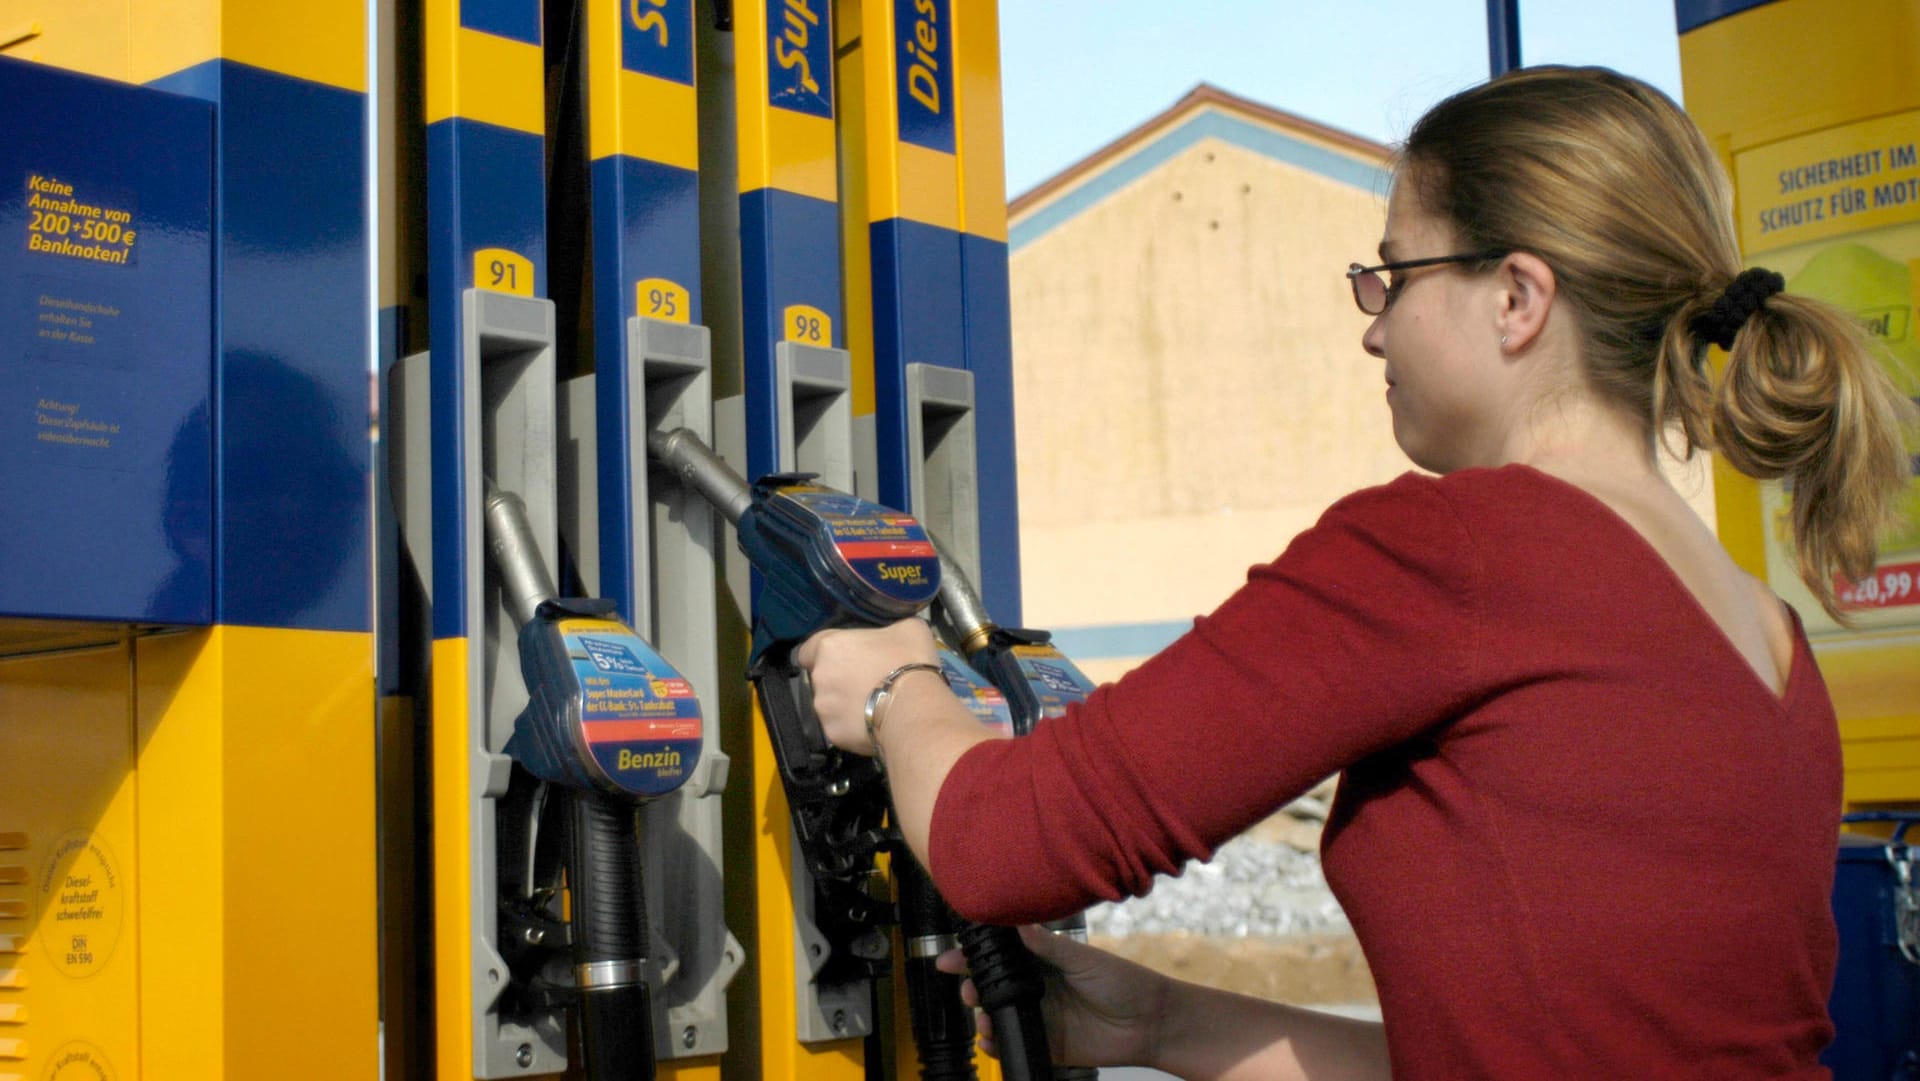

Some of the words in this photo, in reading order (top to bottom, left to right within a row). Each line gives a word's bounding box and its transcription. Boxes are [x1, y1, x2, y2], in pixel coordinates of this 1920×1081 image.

[908, 0, 940, 115] Dies
[1779, 149, 1883, 195] SICHERHEIT
[1888, 143, 1918, 170] IM
[29, 175, 73, 197] Keine
[28, 193, 102, 218] Annahme
[105, 208, 132, 224] von
[1759, 197, 1825, 234] SCHUTZ
[1829, 187, 1868, 217] FÜR
[29, 233, 129, 264] Banknoten!
[490, 259, 518, 290] 91
[649, 288, 677, 317] 95
[795, 314, 821, 342] 98
[878, 563, 921, 584] Super
[618, 745, 680, 770] Benzin
